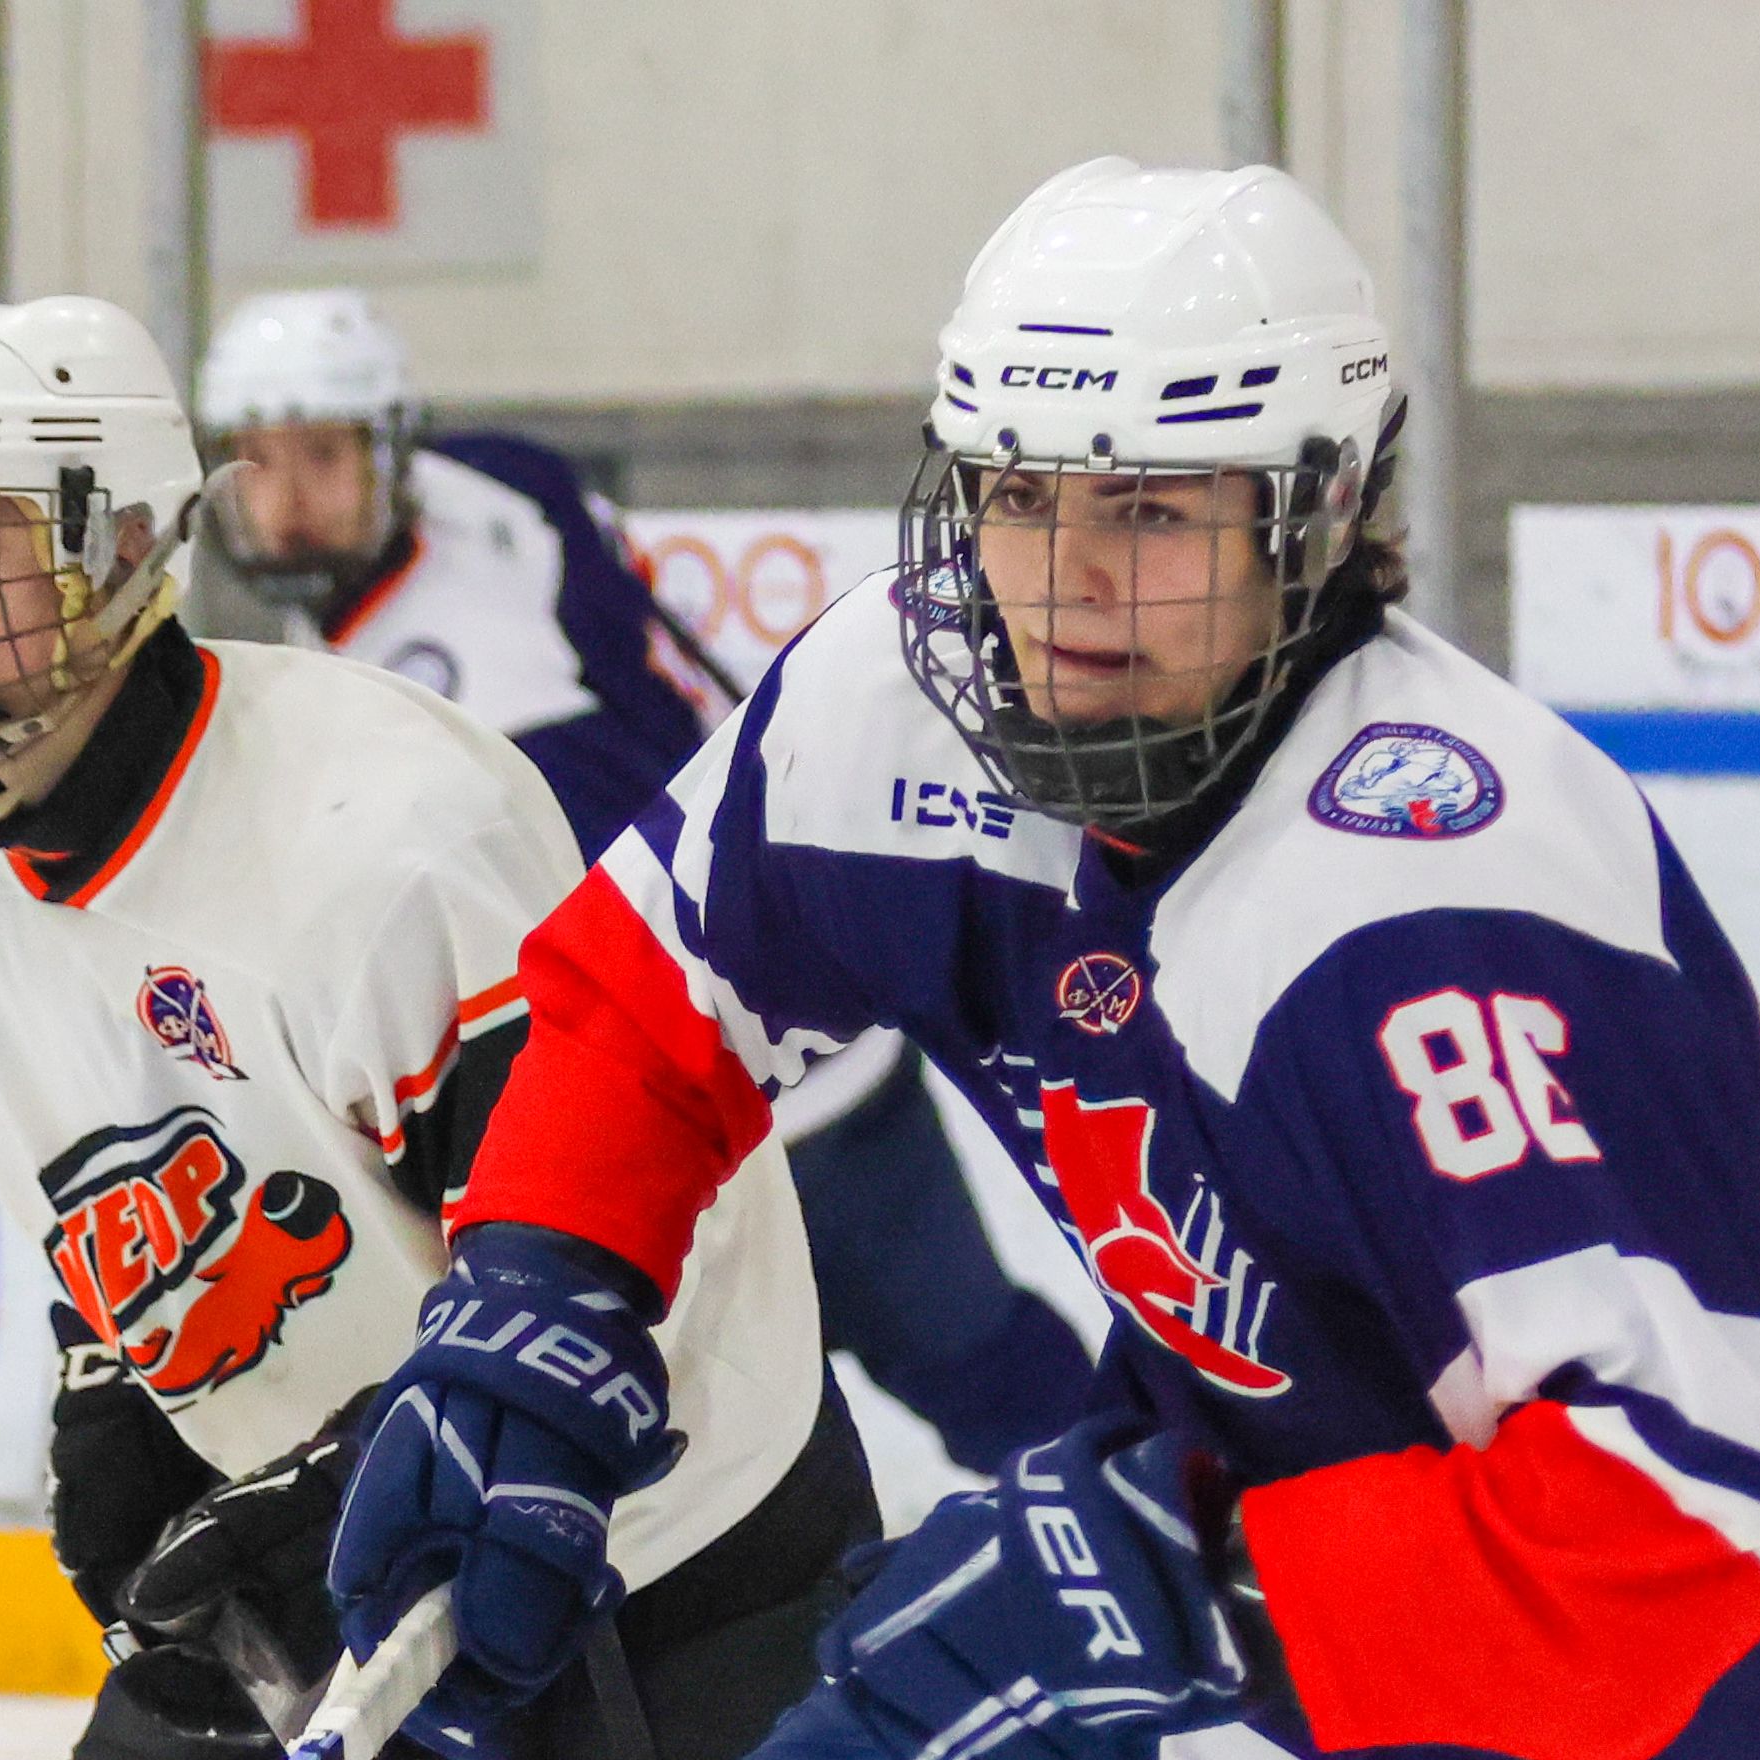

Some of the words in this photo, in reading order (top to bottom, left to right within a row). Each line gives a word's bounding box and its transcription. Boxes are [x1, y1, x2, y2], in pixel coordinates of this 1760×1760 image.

[999, 364, 1120, 393] CCM
[1340, 353, 1388, 385] CCM
[1376, 985, 1604, 1184] 86
